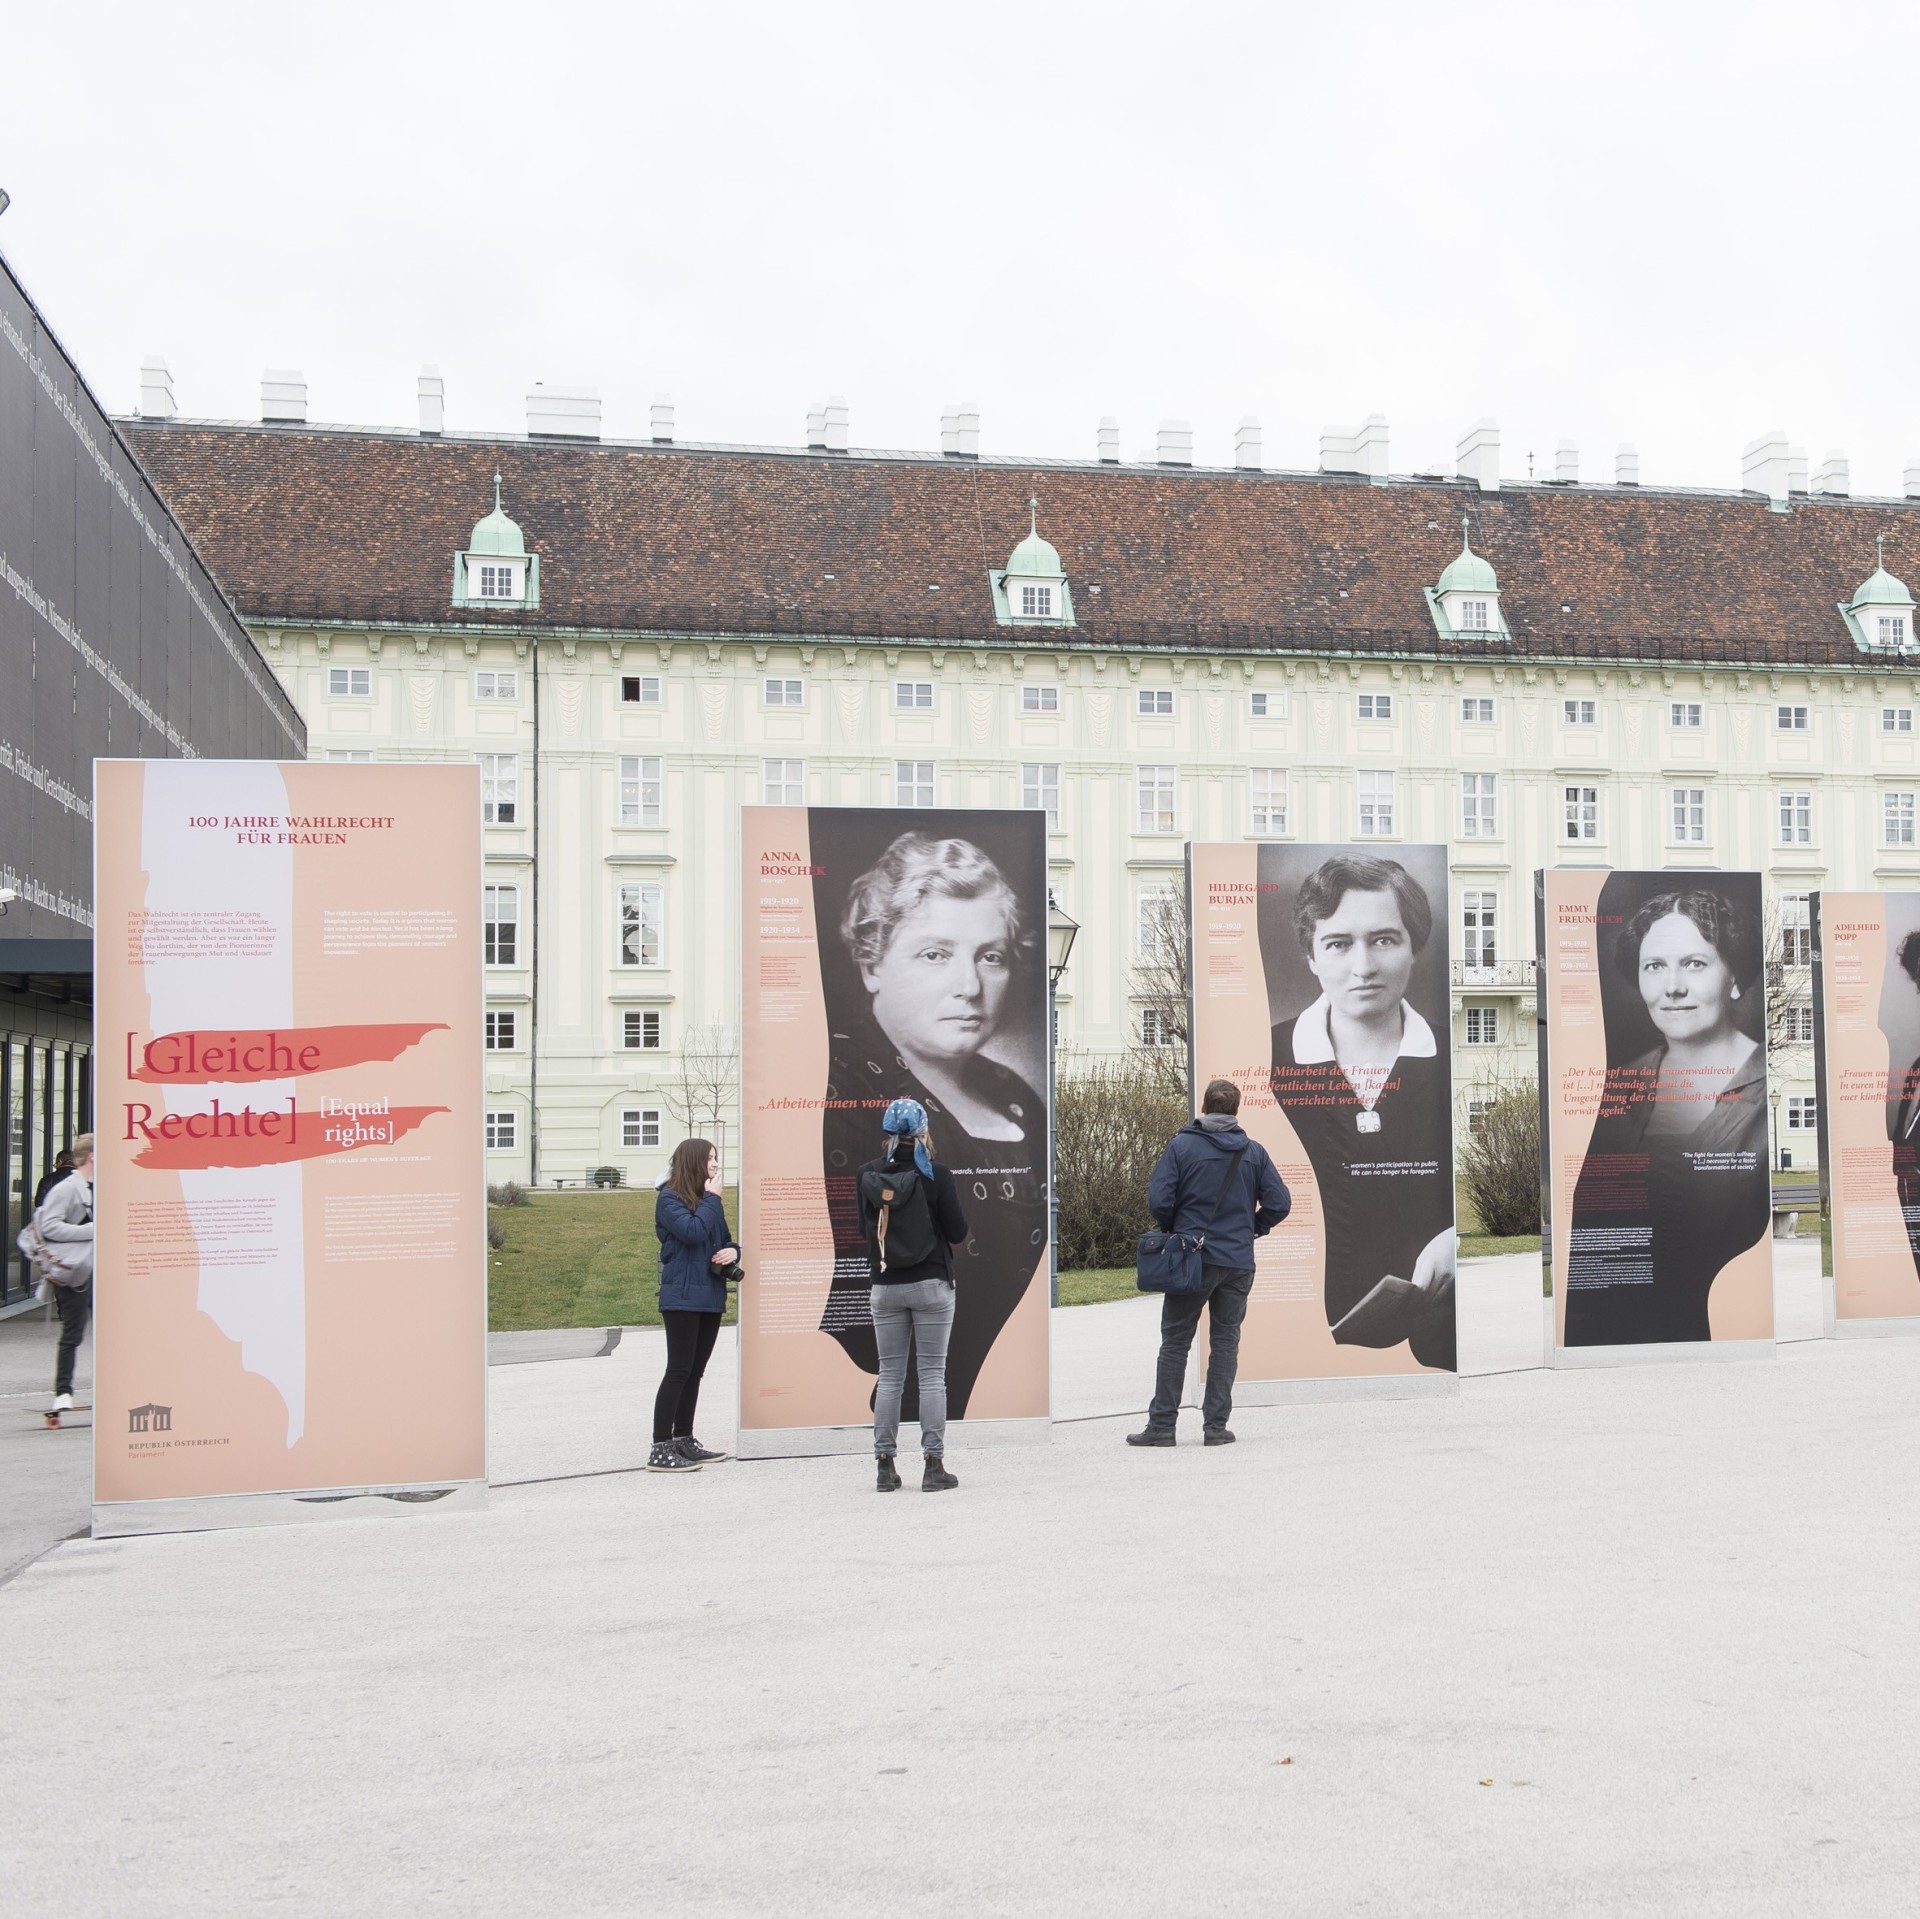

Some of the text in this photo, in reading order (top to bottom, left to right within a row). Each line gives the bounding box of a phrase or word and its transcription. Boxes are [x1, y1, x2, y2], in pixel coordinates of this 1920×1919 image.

[188, 816, 395, 830] 100 JAHRE WAHLRECHT
[237, 830, 347, 844] FÜR FRAUEN
[760, 852, 801, 861] ANNA
[1209, 883, 1279, 892] HILDEGARD
[1209, 896, 1254, 905] BURJAN
[127, 1032, 321, 1080] [Gleiche
[1232, 1065, 1390, 1080] auf die Mitarbeit der Frauen
[1588, 1067, 1620, 1079] Kampf
[1640, 1066, 1656, 1076] das
[1242, 1081, 1256, 1092] im
[1260, 1080, 1325, 1096] öffentlichen
[1328, 1080, 1360, 1091] Leben
[1563, 1080, 1574, 1090] ist
[1243, 1096, 1277, 1108] länger
[1282, 1095, 1335, 1106] verzichtet
[1564, 1093, 1627, 1105] Umgestaltung
[1629, 1092, 1645, 1101] der
[320, 1096, 390, 1123] [Equal
[122, 1097, 296, 1144] Rechte]
[324, 1122, 394, 1147] rights]
[128, 1438, 230, 1450] REPUBLIK ÖSTERREICH
